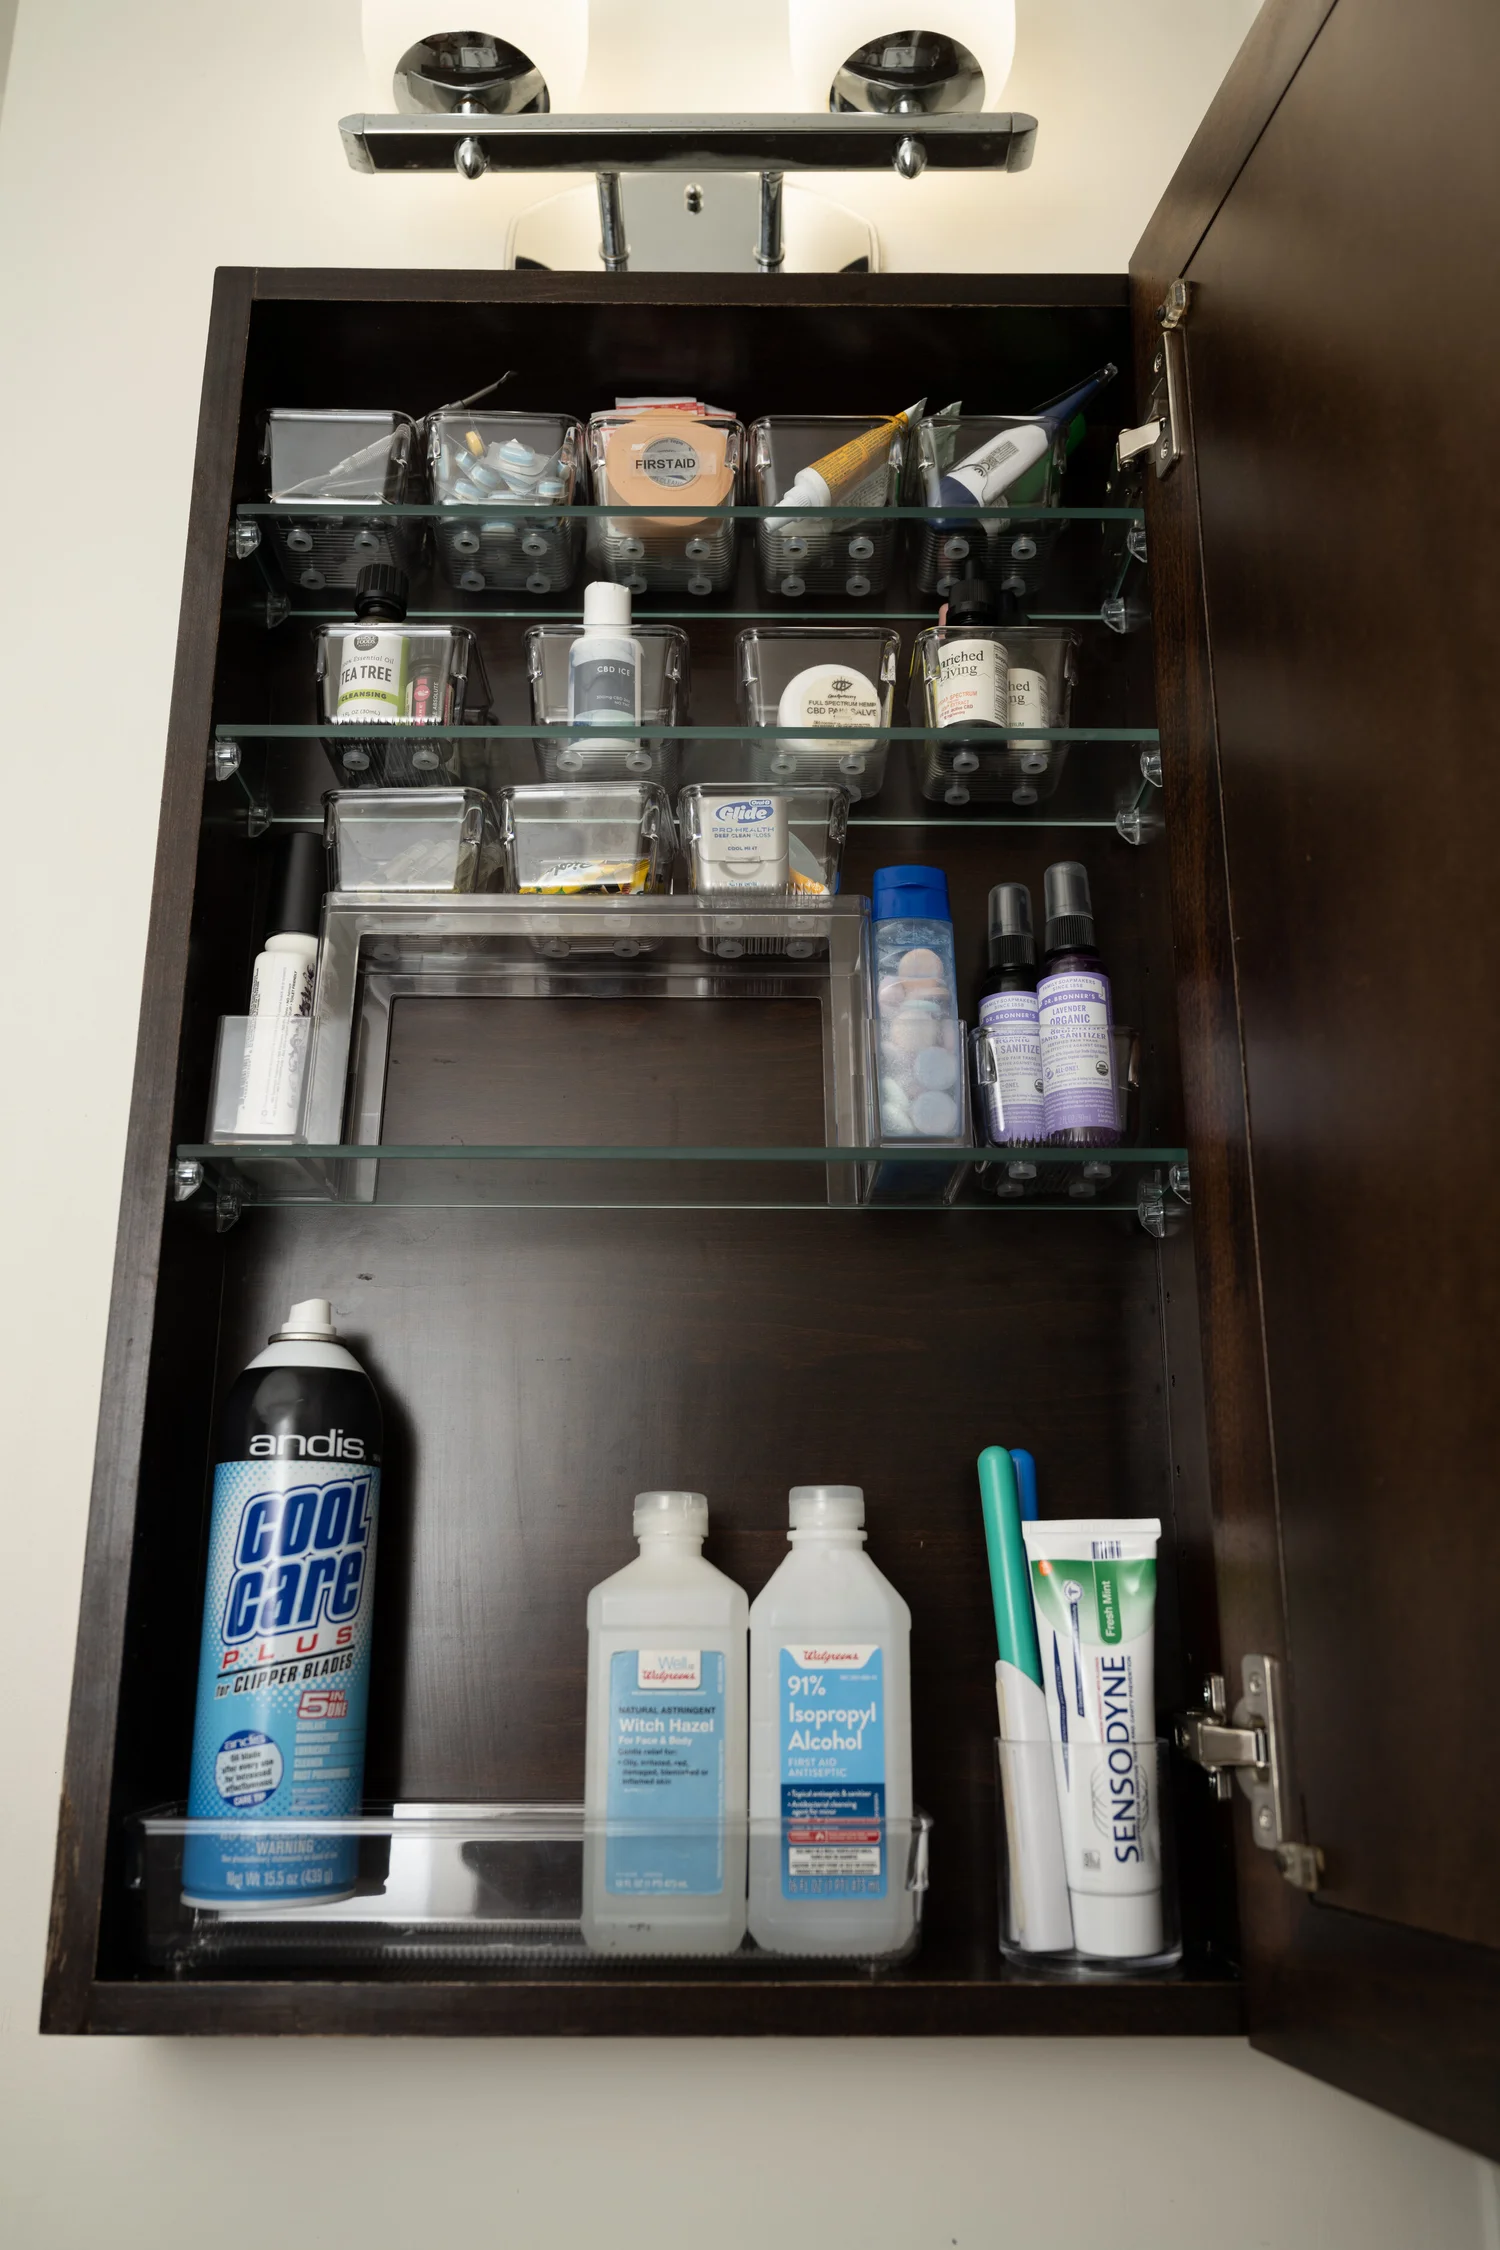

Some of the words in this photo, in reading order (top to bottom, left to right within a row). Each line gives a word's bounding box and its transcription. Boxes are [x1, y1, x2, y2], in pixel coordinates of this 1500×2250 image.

[353, 655, 383, 663] Essential
[384, 656, 395, 665] Oil
[341, 667, 357, 685] TEA
[360, 665, 392, 682] TREE
[596, 665, 616, 673] CBD
[618, 667, 631, 677] ICE
[341, 690, 387, 702] CLEANSING
[806, 706, 826, 715] CBD
[718, 805, 768, 820] Glide
[1053, 993, 1096, 1002] BRONNER'S
[995, 1012, 1036, 1020] BRONNER'S
[1052, 1004, 1087, 1016] LAVENDER
[1050, 1013, 1091, 1026] ORGANIC
[1060, 1032, 1107, 1041] SANITIZER
[1000, 1044, 1041, 1055] SANITIZE
[250, 1429, 364, 1459] andis
[1101, 1580, 1113, 1605] Mint
[1104, 1606, 1116, 1637] Fresh
[222, 1626, 353, 1669] PLUS
[657, 1656, 688, 1670] Well
[803, 1649, 860, 1664] Walgreens
[215, 1685, 230, 1698] for
[233, 1665, 299, 1693] CLIPPER
[302, 1652, 353, 1680] BLADES
[642, 1670, 696, 1684] Walgreens
[787, 1674, 827, 1697] 91%
[299, 1692, 329, 1718] 5
[330, 1691, 345, 1701] IN
[327, 1702, 347, 1717] ONE
[618, 1706, 659, 1715] NATURAL
[660, 1706, 717, 1715] ASTRINGENT
[788, 1700, 877, 1731] Isopropyl
[619, 1718, 666, 1733] Witch
[669, 1718, 715, 1733] Hazel
[224, 1733, 266, 1751] andis
[618, 1735, 634, 1745] For
[635, 1735, 659, 1745] Face
[659, 1735, 667, 1745] &
[668, 1735, 693, 1747] Body
[788, 1729, 863, 1750] Alcohol
[787, 1757, 816, 1767] FIRST
[817, 1757, 838, 1767] AID
[1100, 1656, 1140, 1863] SENSODYNE
[787, 1767, 848, 1778] ANTISEPTIC
[256, 1839, 315, 1855] WARNING
[263, 1869, 285, 1887] 15.5
[285, 1873, 299, 1886] oz
